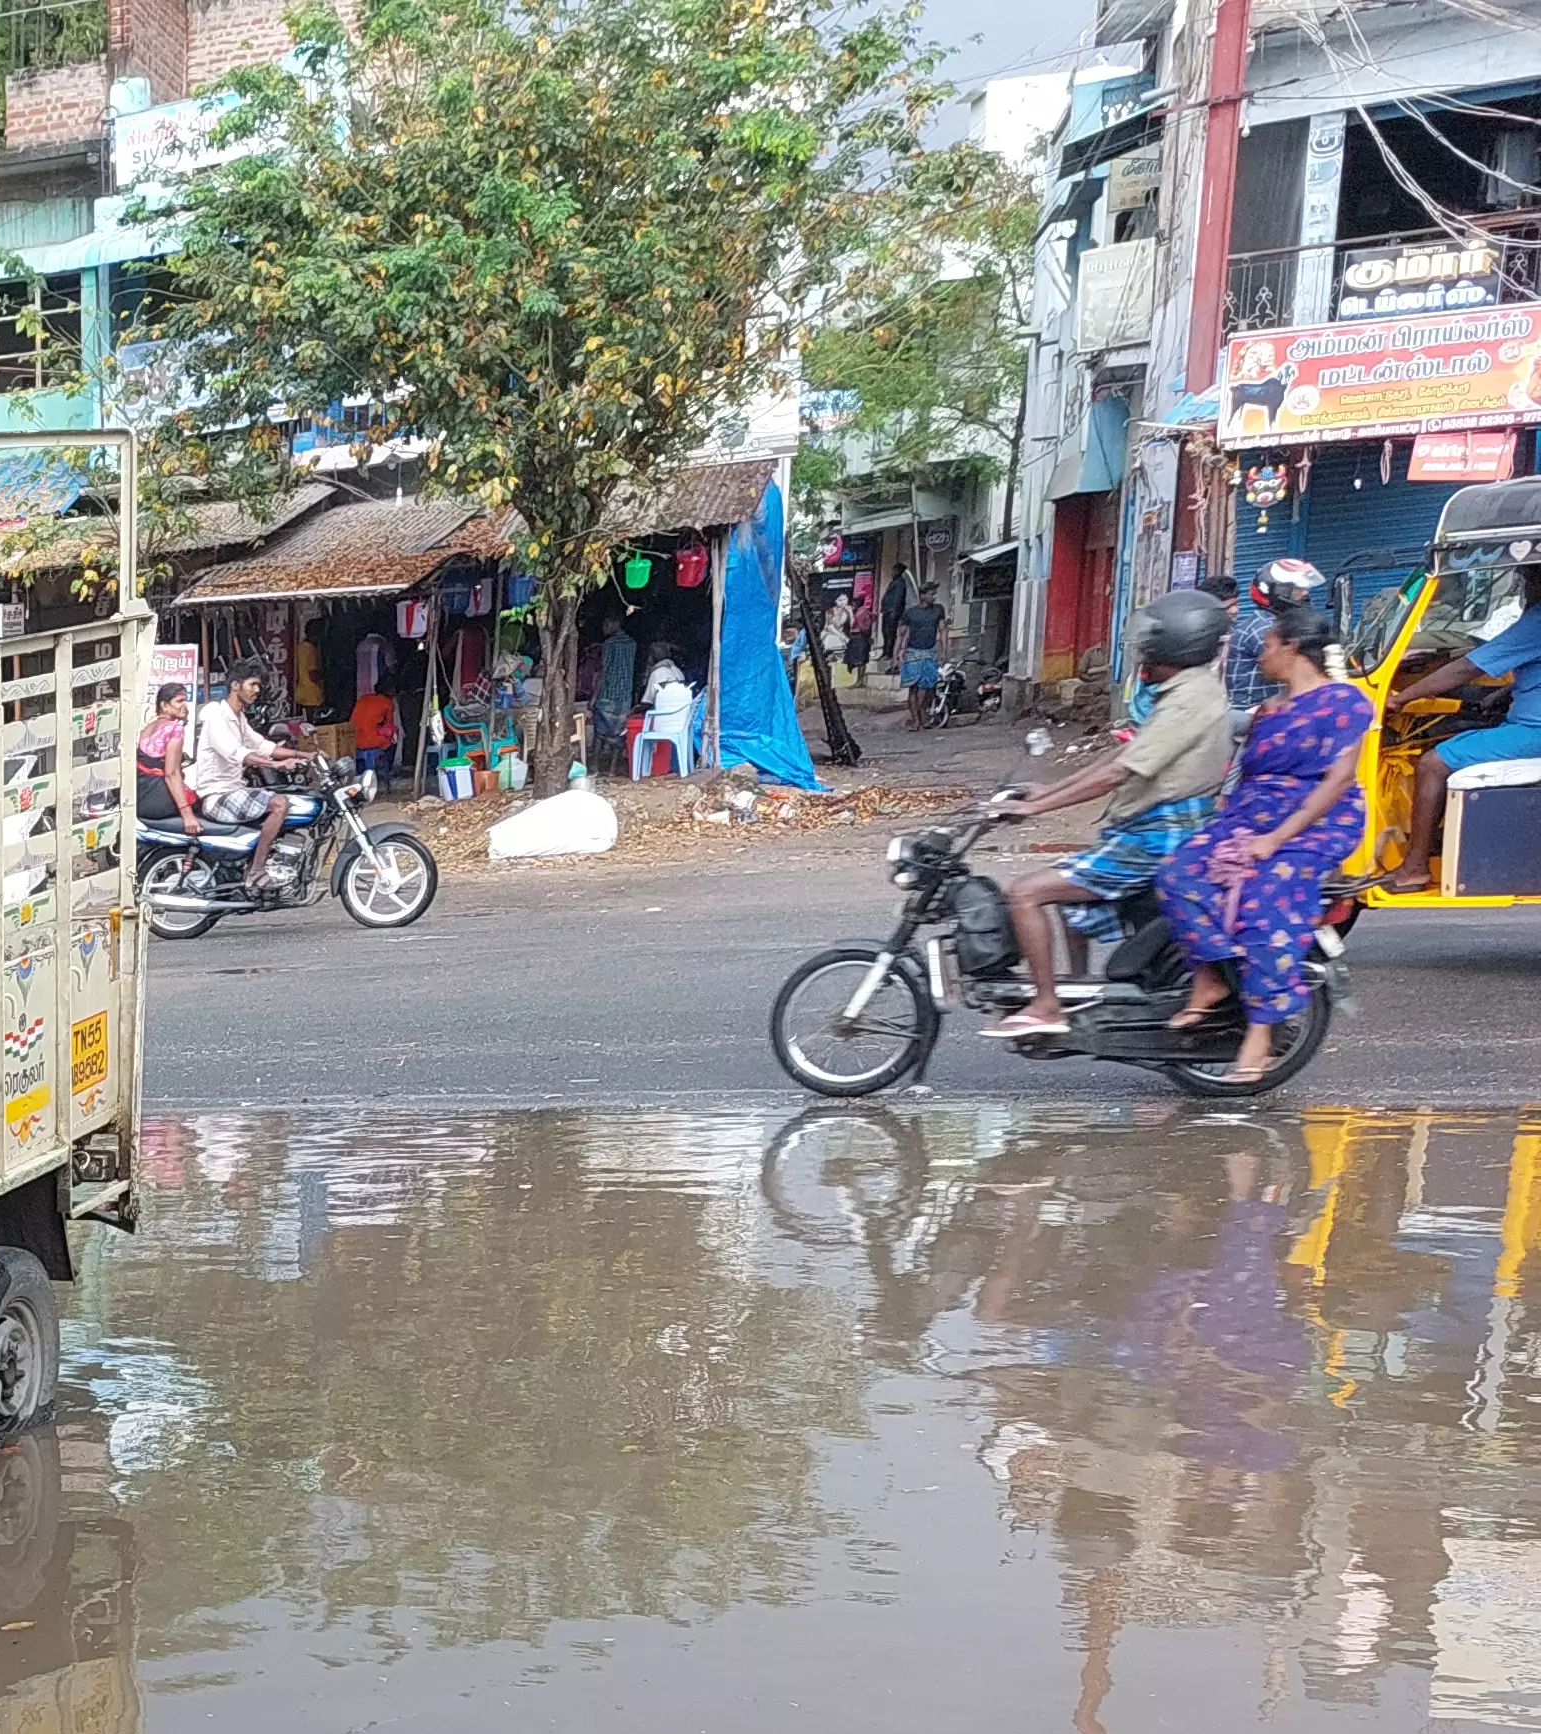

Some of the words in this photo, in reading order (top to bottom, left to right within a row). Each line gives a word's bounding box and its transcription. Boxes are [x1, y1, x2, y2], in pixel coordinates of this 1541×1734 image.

[1345, 240, 1499, 291] குமார்
[1288, 328, 1388, 360] அம்மன்
[1320, 359, 1406, 388] மட்டன்
[73, 1018, 102, 1055] TN55
